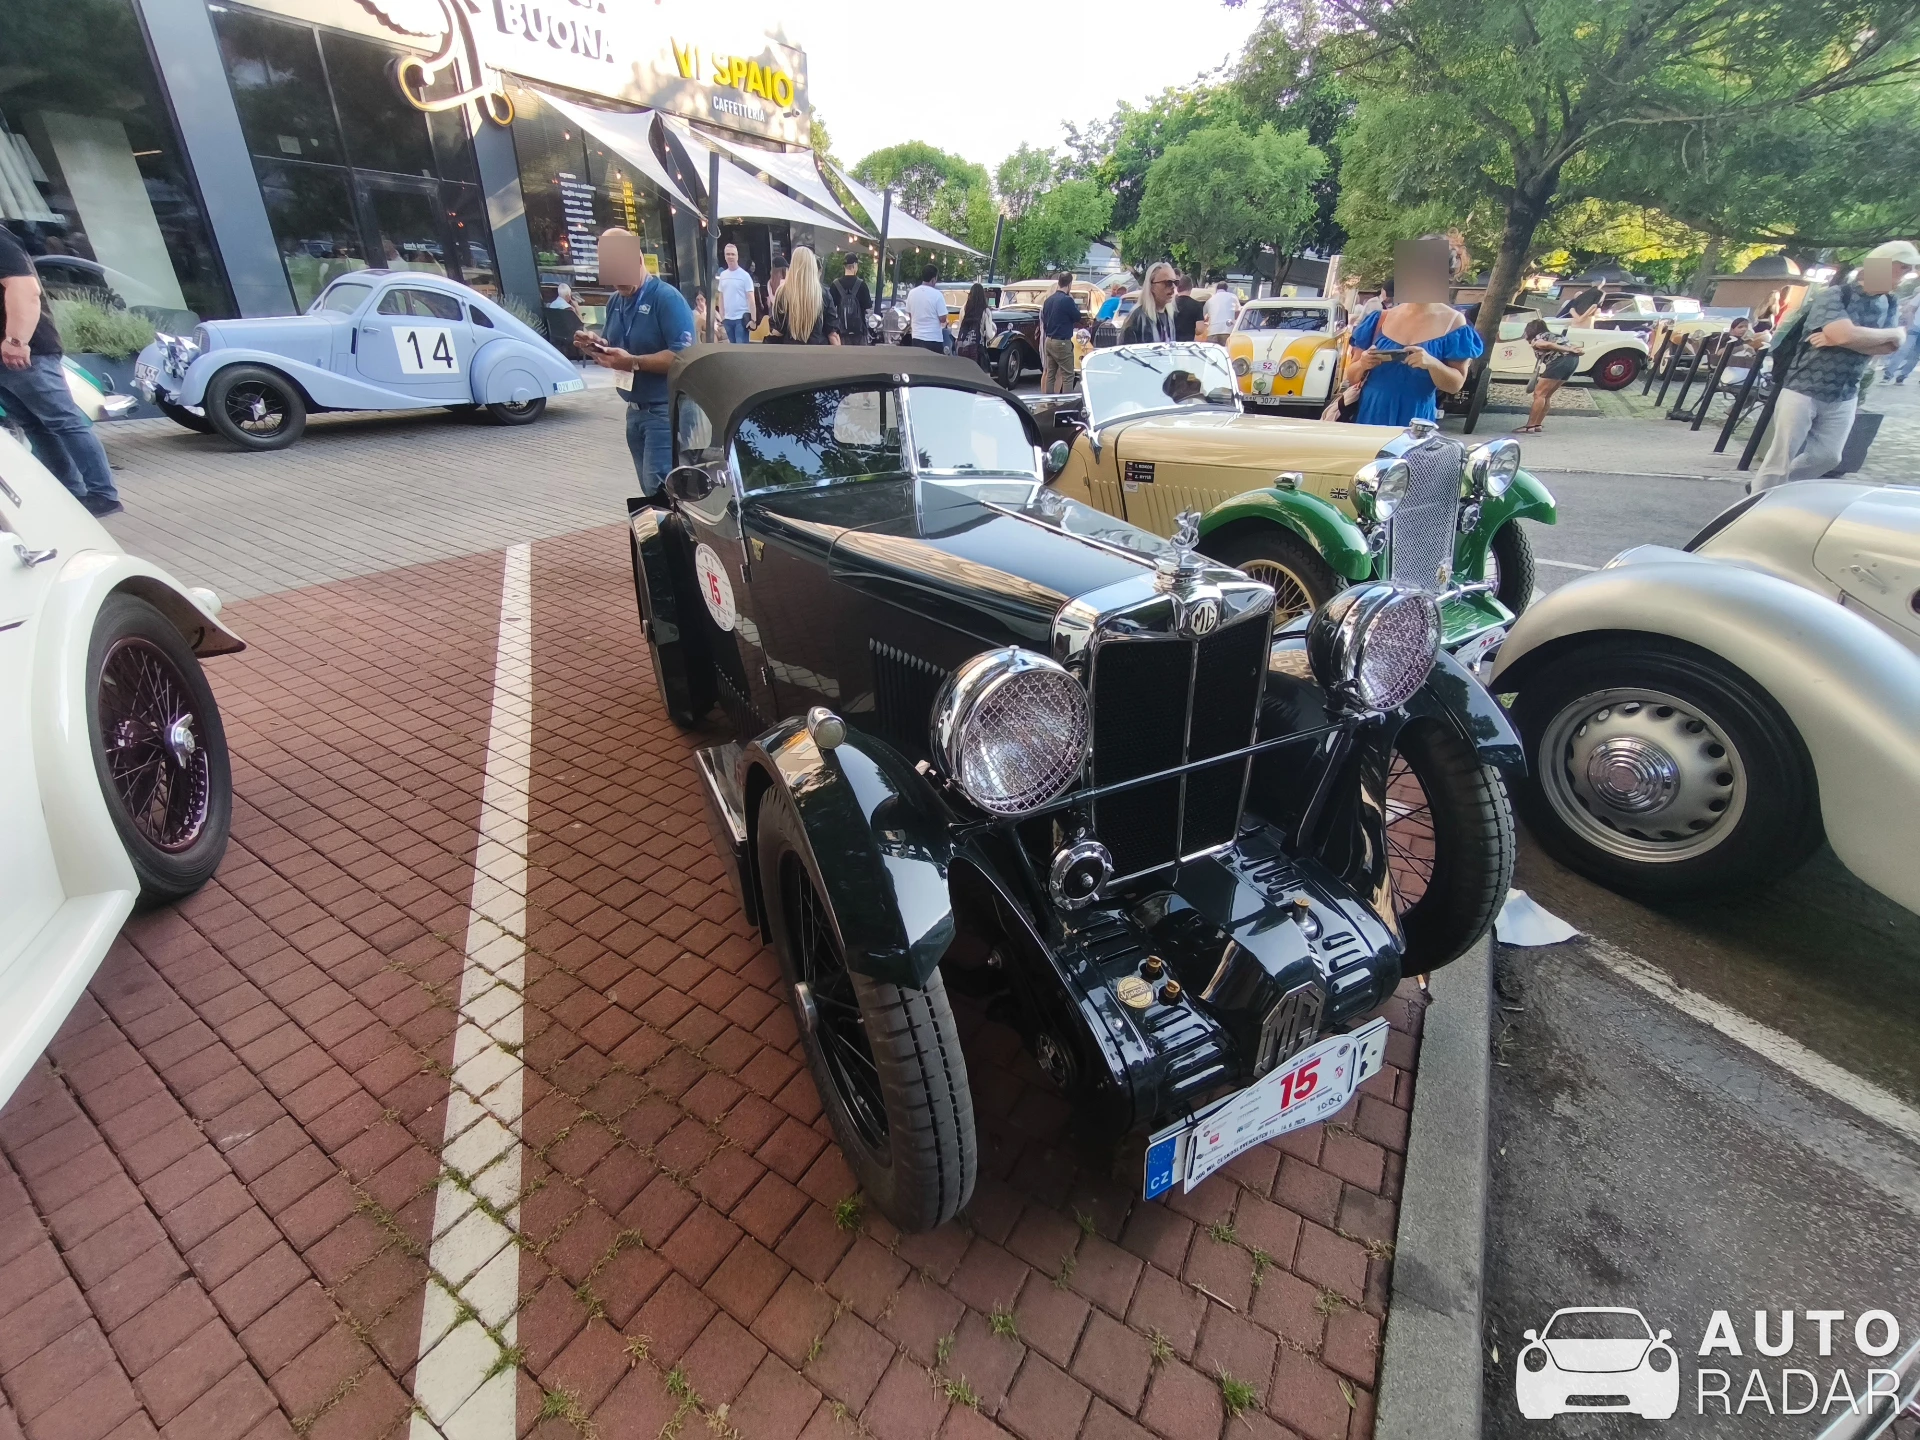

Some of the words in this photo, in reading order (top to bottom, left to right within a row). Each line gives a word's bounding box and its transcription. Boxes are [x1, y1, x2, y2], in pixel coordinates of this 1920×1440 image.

[713, 96, 766, 123] CAFFETTERIA
[407, 331, 453, 369] 14
[1262, 362, 1272, 370] 52
[706, 571, 722, 605] 15
[1194, 606, 1216, 633] MG
[1256, 988, 1322, 1078] MG
[1280, 1057, 1322, 1110] 15
[1150, 1170, 1170, 1190] CZ
